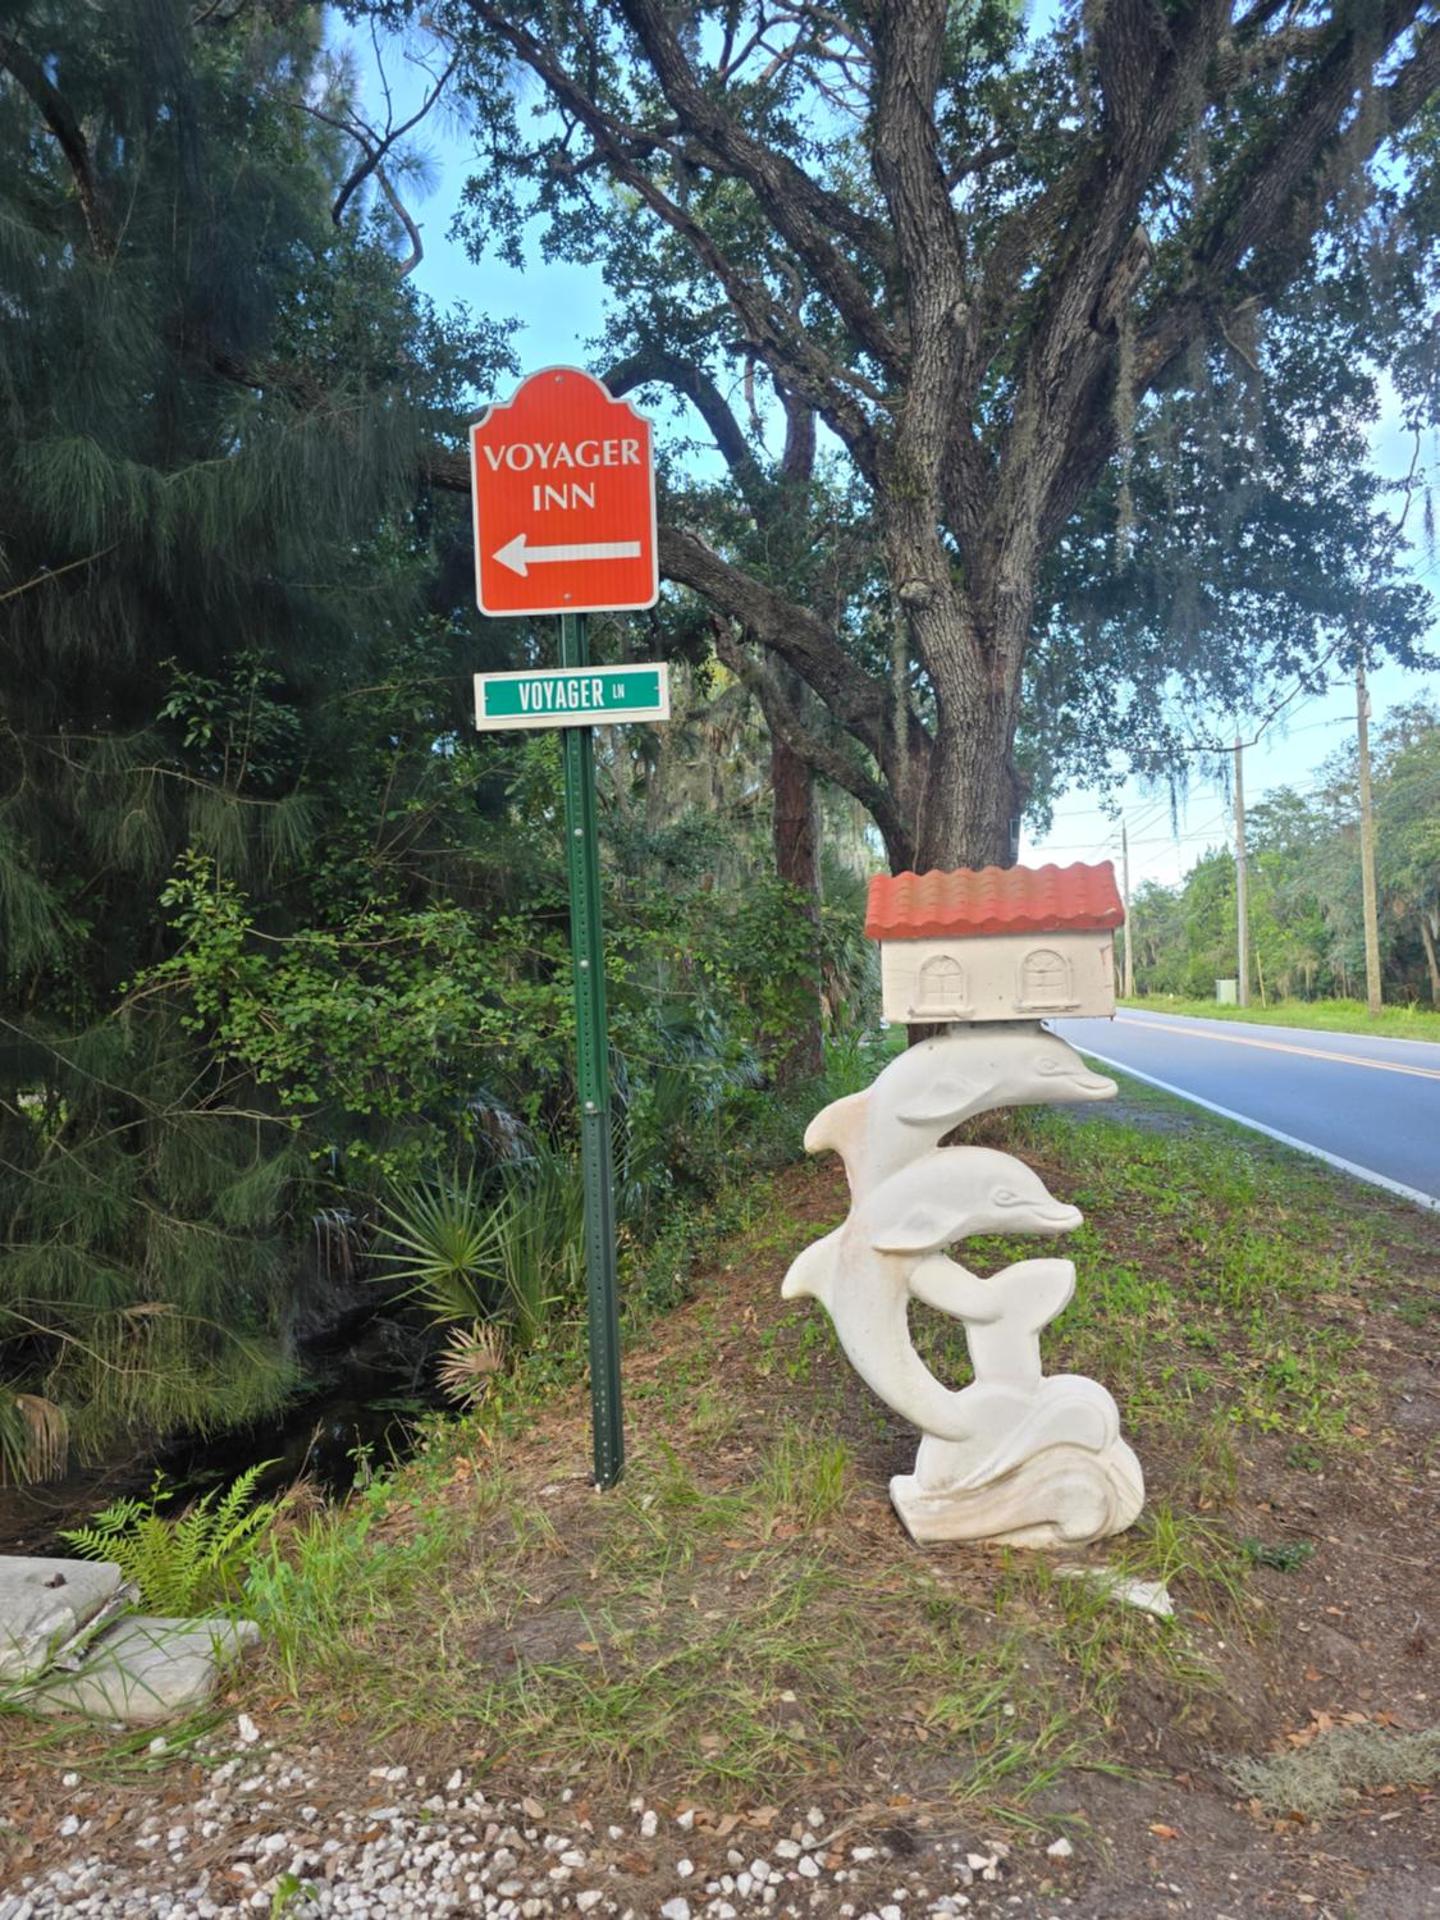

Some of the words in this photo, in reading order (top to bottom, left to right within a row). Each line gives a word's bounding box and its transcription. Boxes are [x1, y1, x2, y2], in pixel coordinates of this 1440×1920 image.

[483, 438, 641, 471] VOYAGER
[533, 482, 595, 511] INN
[518, 678, 605, 711] VOYAGER
[612, 683, 625, 699] LN
